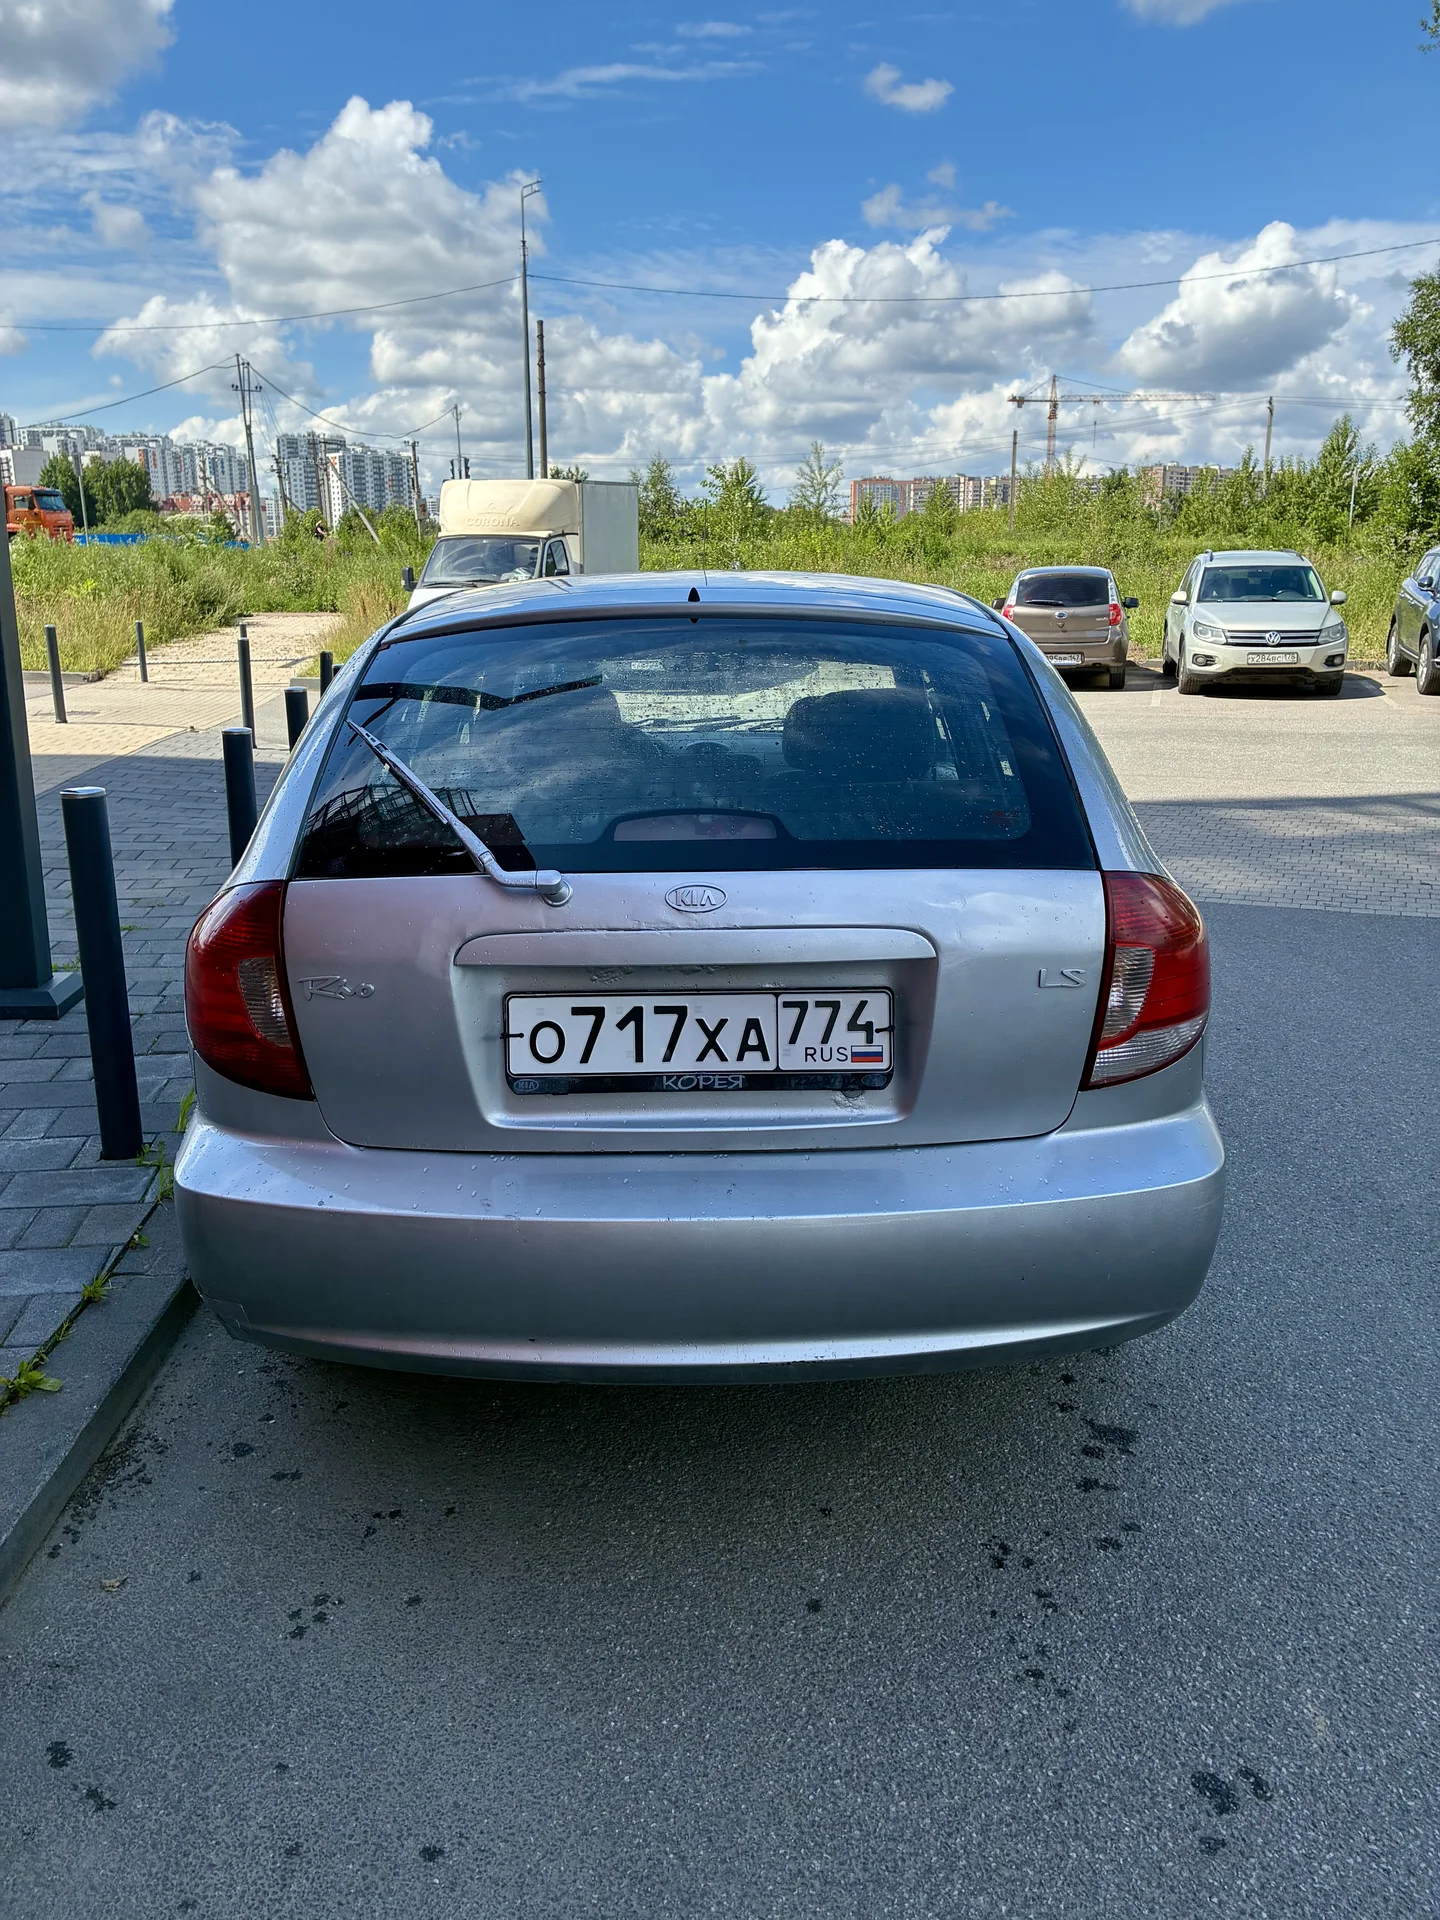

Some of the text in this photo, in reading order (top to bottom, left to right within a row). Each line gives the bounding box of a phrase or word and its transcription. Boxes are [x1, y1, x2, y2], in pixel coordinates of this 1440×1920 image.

[466, 517, 520, 527] CORONA
[675, 889, 717, 907] KIA
[1038, 967, 1086, 988] LS
[297, 975, 376, 1001] Rio
[529, 1000, 874, 1065] О717ХА 774
[804, 1046, 848, 1063] RUS
[662, 1075, 745, 1090] КОРЕЯ
